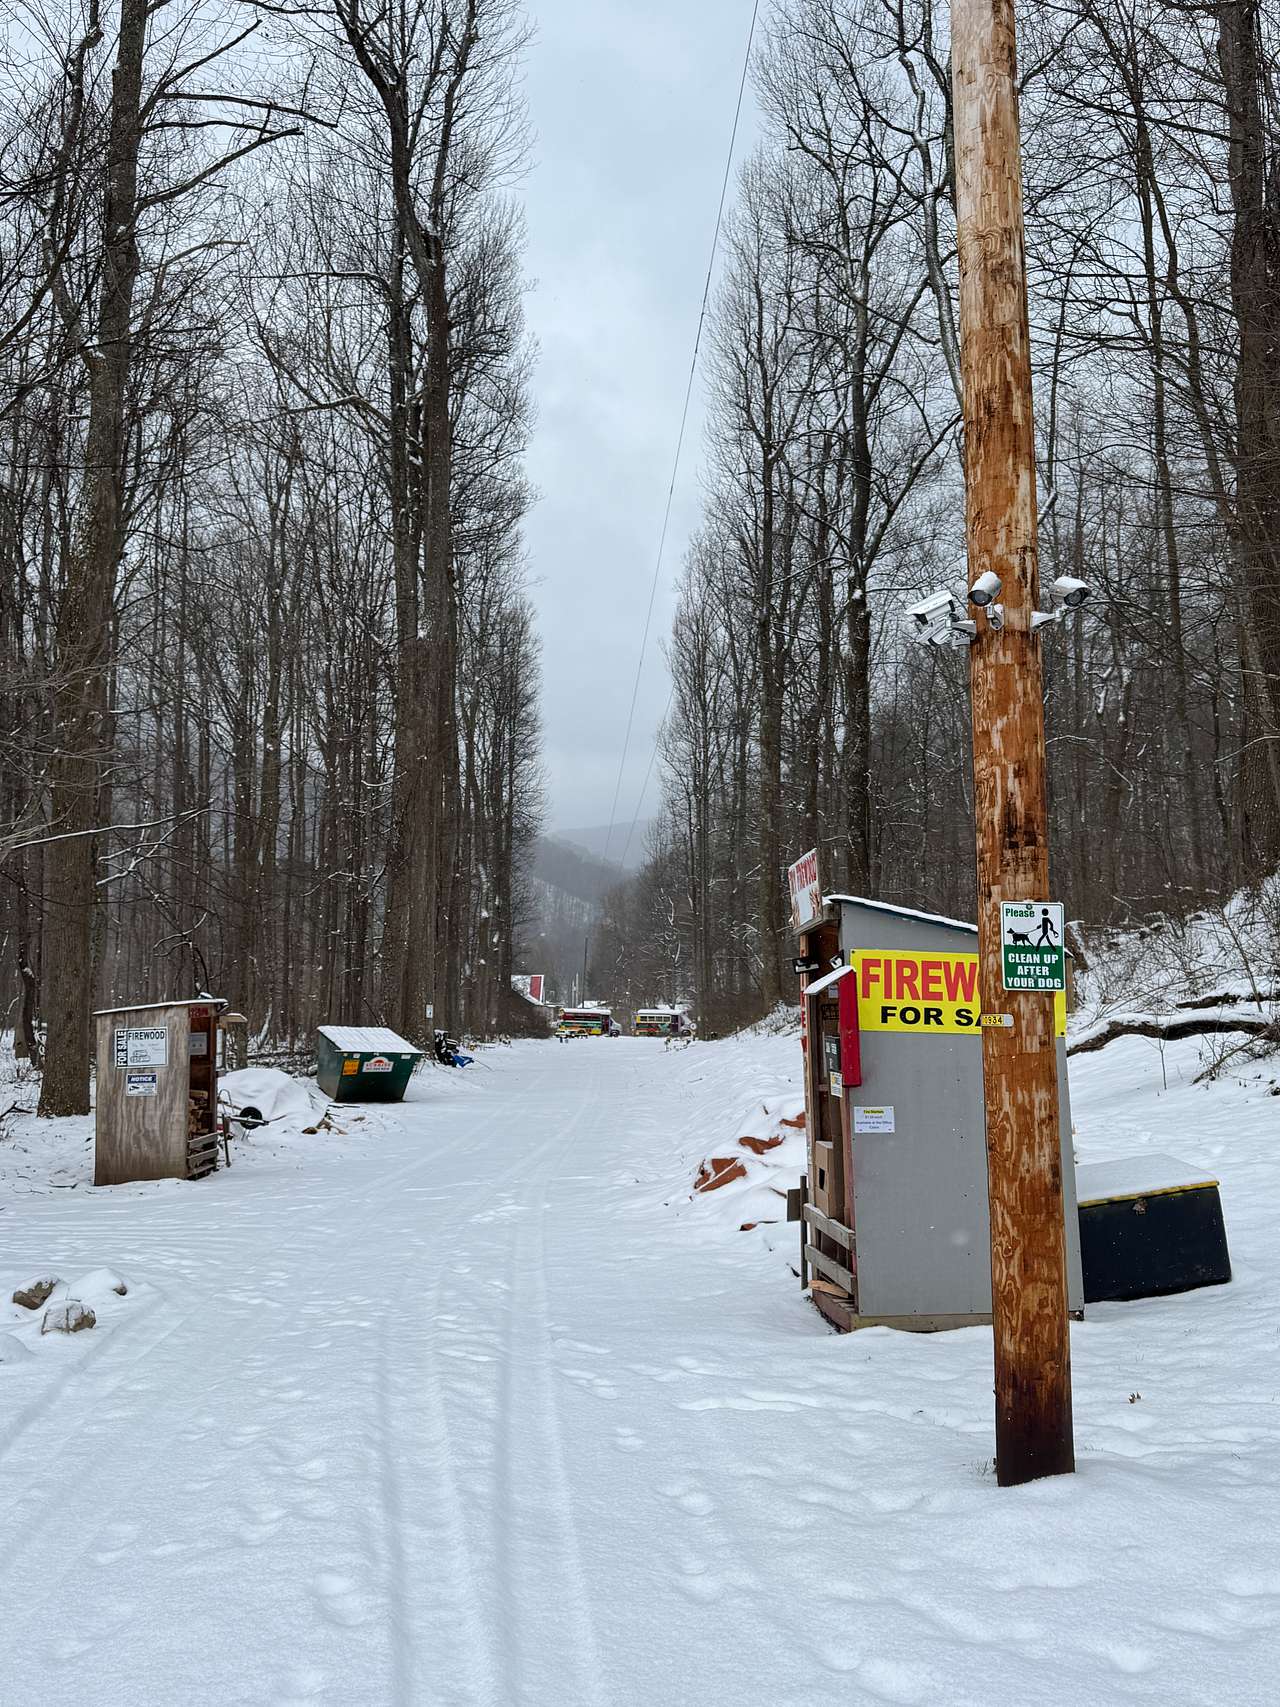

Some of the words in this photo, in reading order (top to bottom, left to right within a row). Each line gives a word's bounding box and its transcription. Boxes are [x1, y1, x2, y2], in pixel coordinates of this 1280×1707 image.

[1005, 907, 1035, 918] Please
[1008, 953, 1040, 963] CLEAN
[1043, 954, 1059, 964] UP
[1017, 965, 1050, 976] AFTER
[861, 958, 980, 1002] FIREW
[1007, 977, 1035, 987] YOUR
[1038, 978, 1062, 988] DOG
[880, 1005, 944, 1025] FOR
[117, 1031, 128, 1050] SALE
[128, 1031, 165, 1040] FIREWOOD
[117, 1051, 127, 1066] FOR
